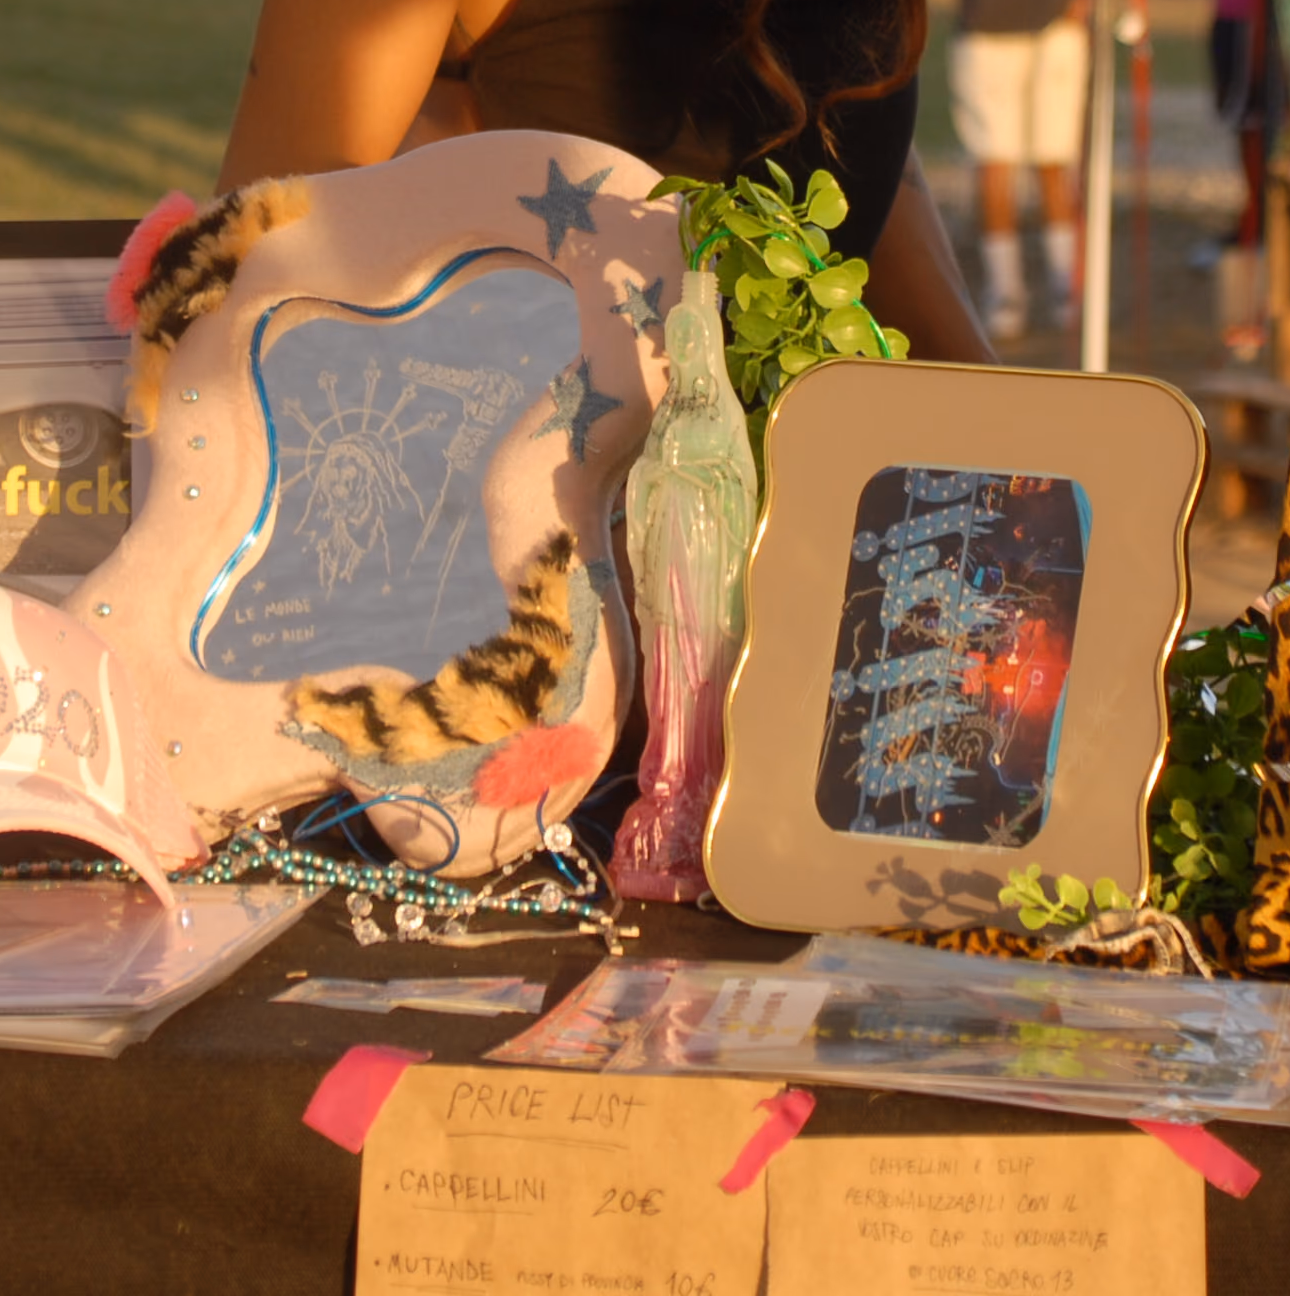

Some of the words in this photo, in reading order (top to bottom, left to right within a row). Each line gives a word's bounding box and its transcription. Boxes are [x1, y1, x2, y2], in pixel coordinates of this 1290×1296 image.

[0, 465, 131, 516] fuck
[235, 607, 256, 624] LE
[264, 598, 311, 619] MONDE
[446, 1081, 549, 1121] PRICE
[567, 1092, 647, 1130] LIST
[399, 1168, 547, 1206] CAPPELLINI
[592, 1187, 666, 1217] 20€
[386, 1253, 495, 1284] MUTANDE
